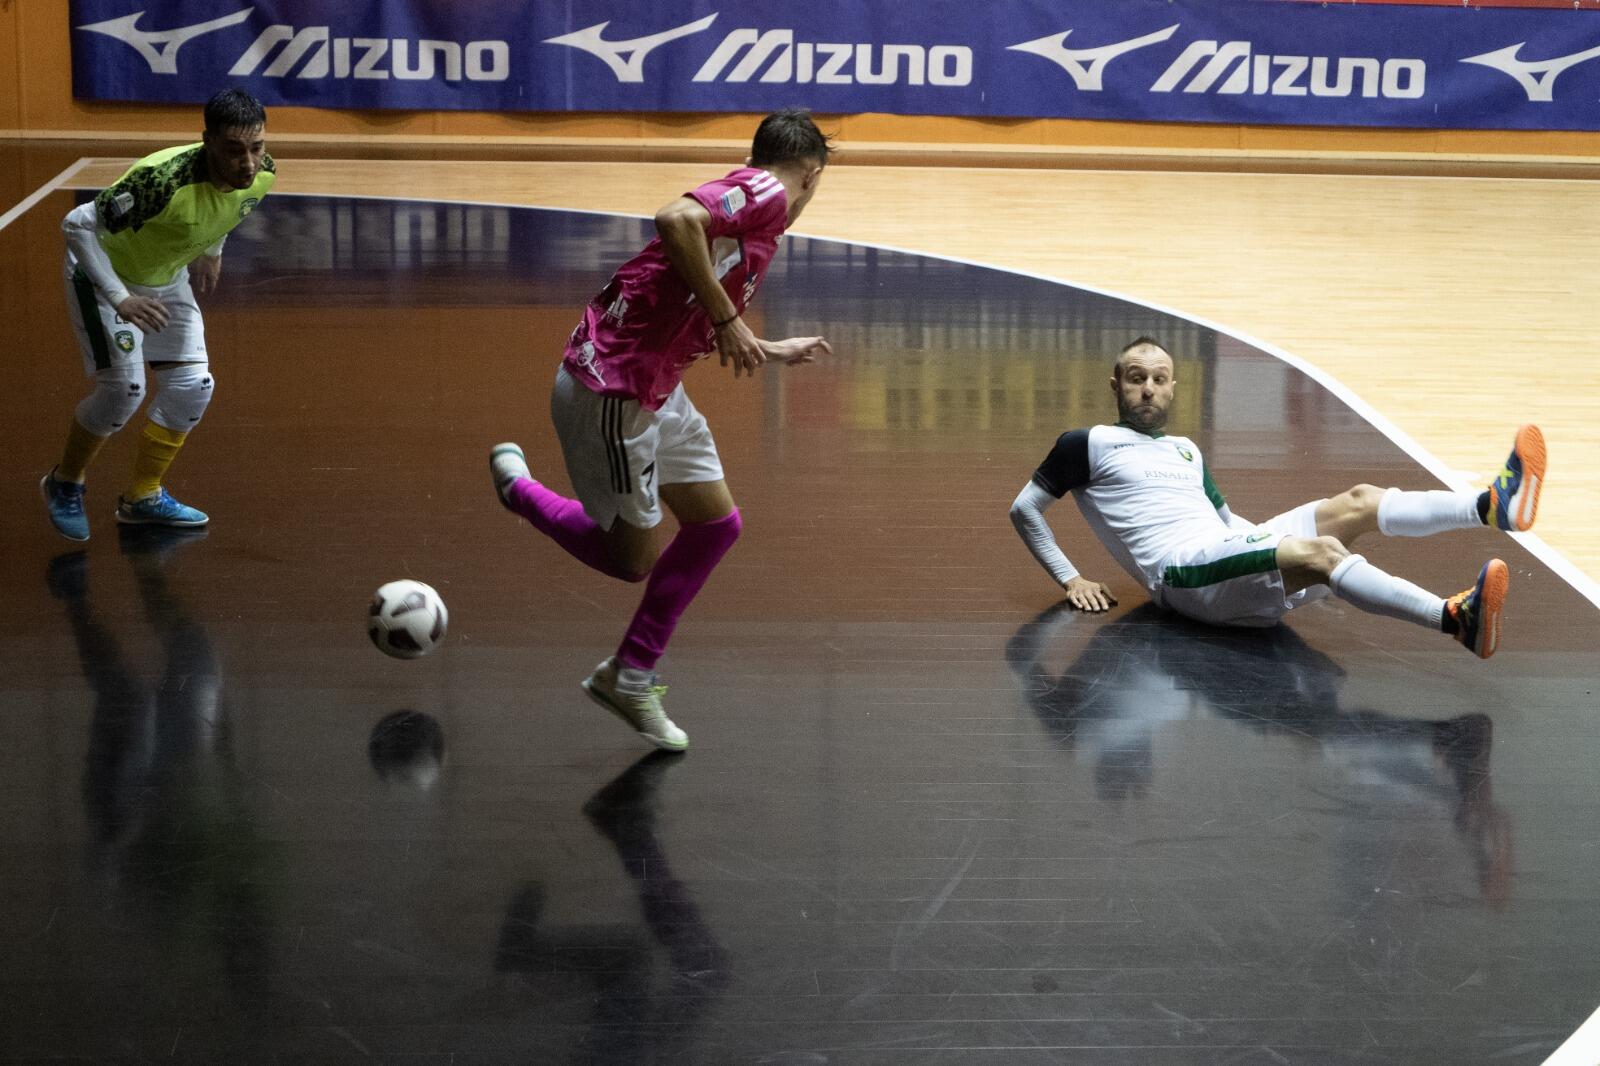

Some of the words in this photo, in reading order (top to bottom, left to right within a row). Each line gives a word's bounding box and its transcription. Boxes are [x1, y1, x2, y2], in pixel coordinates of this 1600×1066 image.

[228, 25, 509, 81] MIZUNO
[692, 28, 973, 86] MIZUNO
[1150, 39, 1426, 99] MIZUNO
